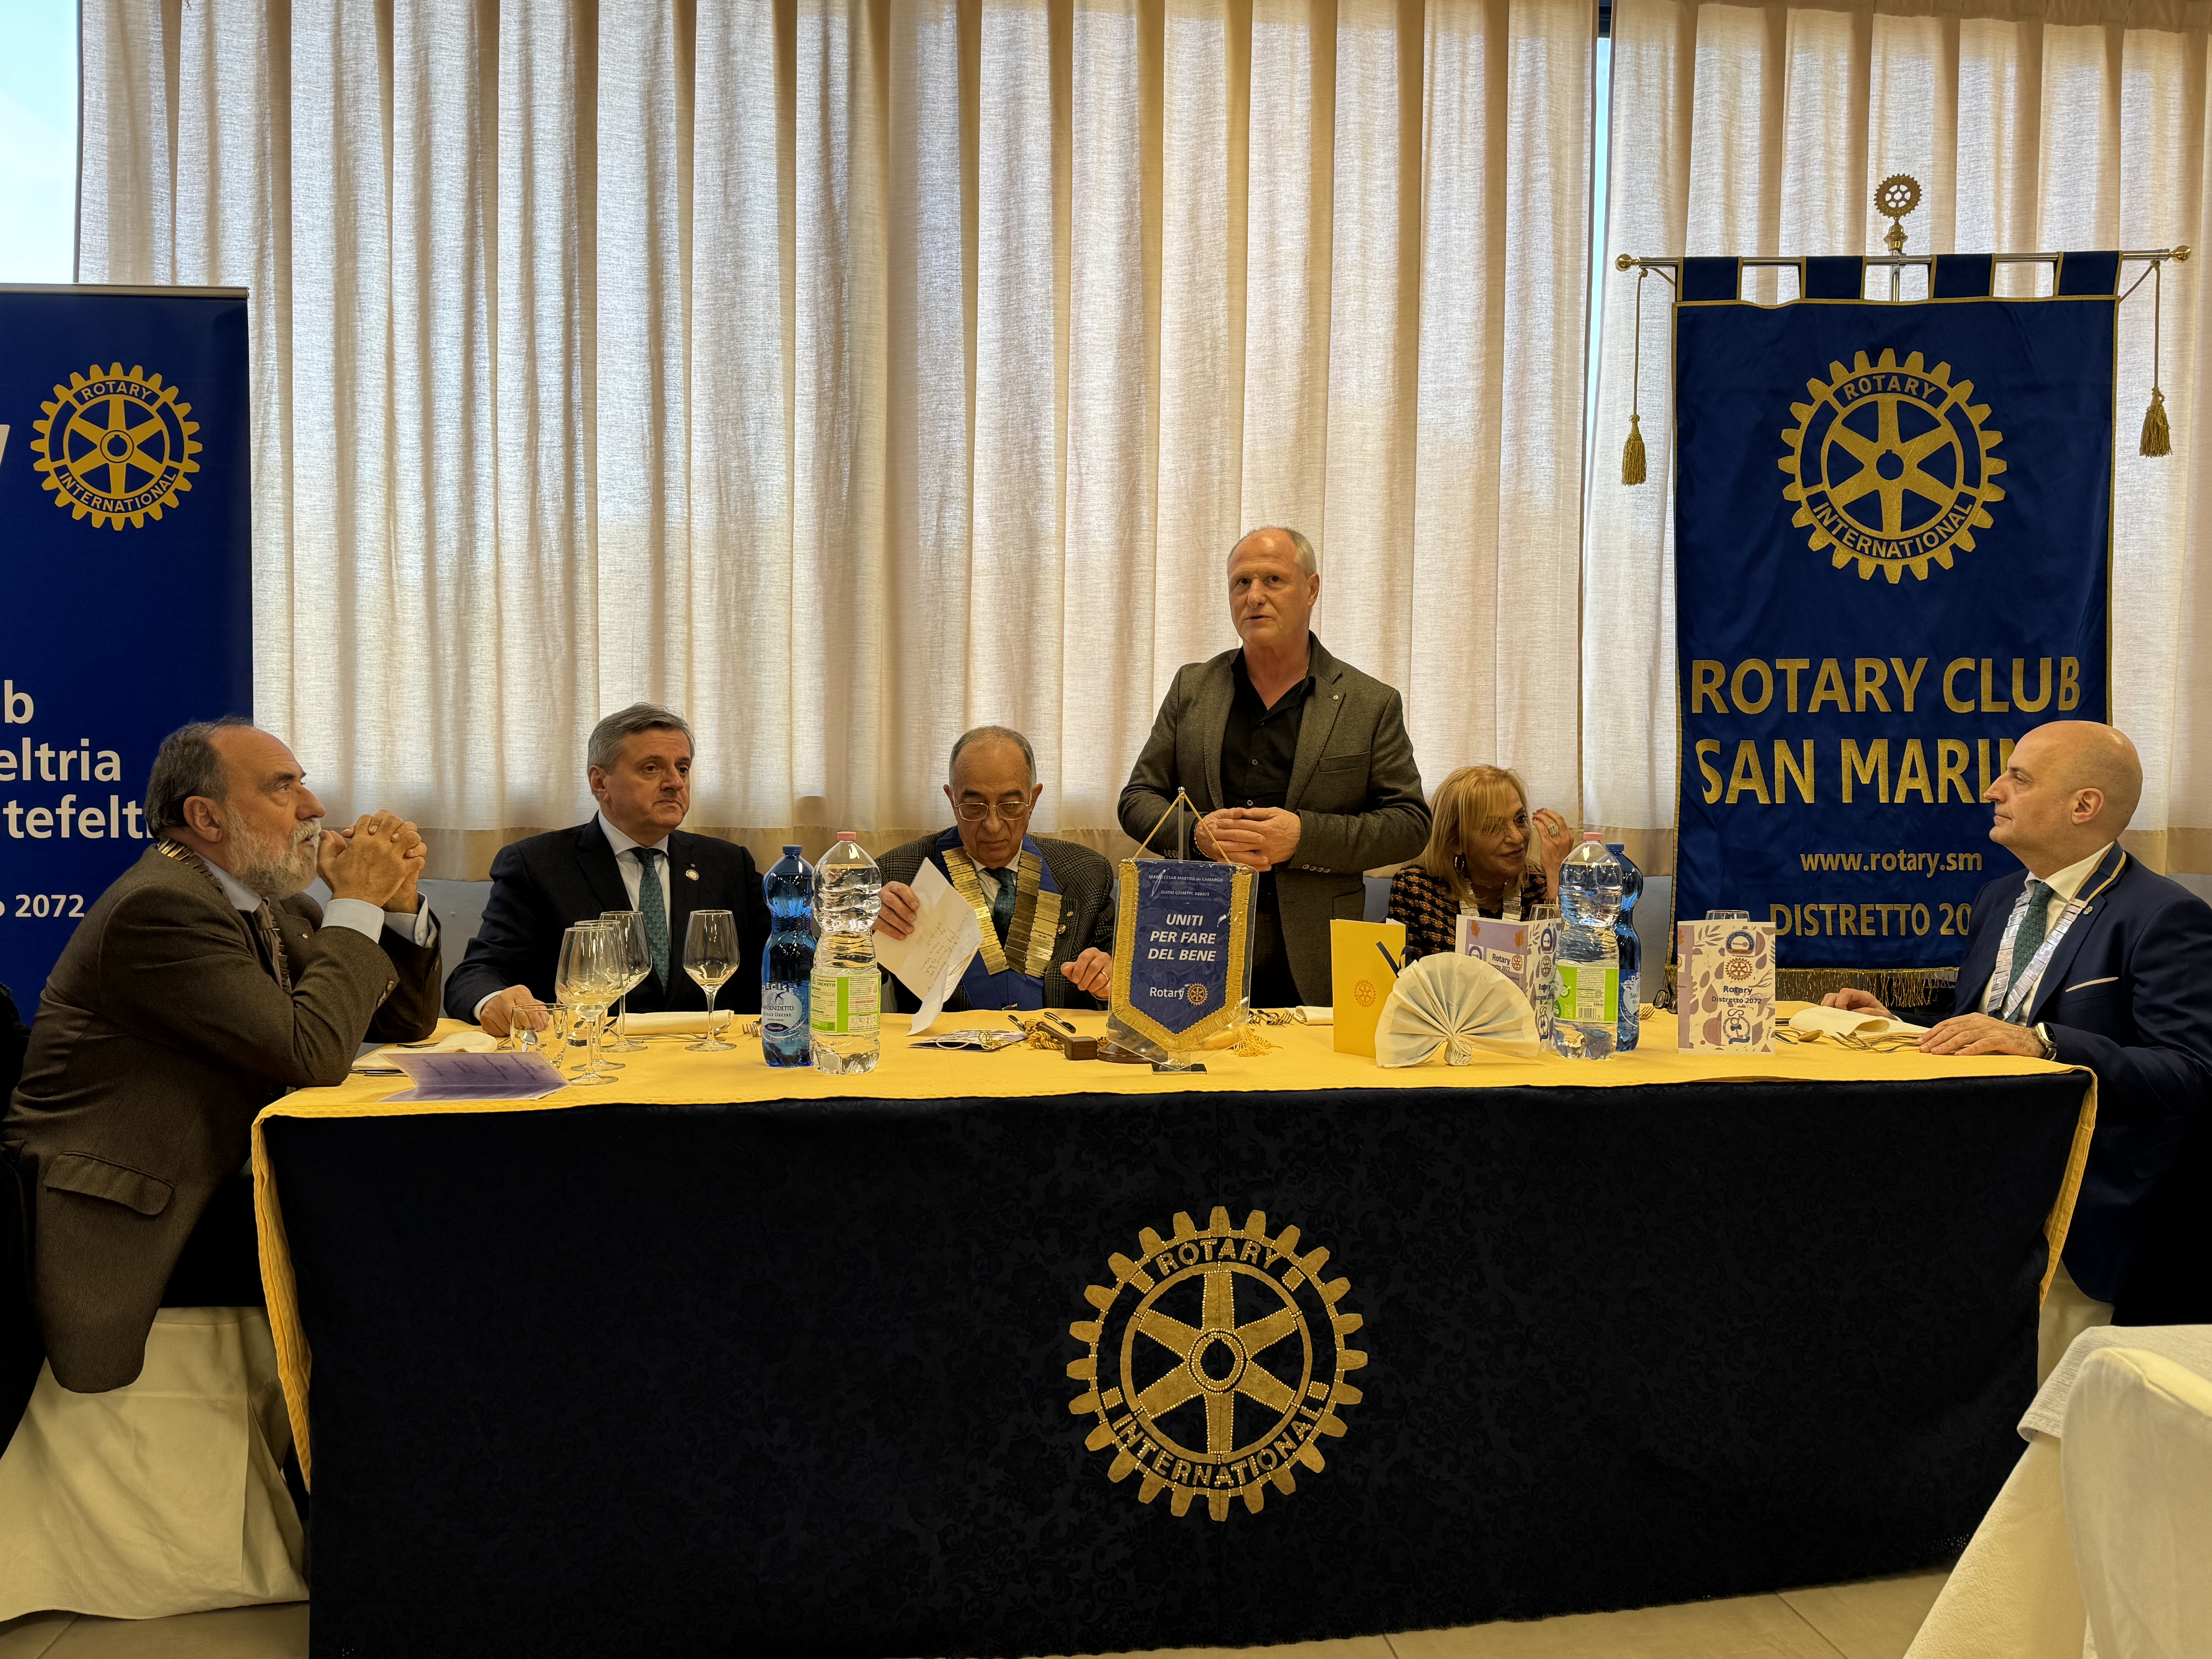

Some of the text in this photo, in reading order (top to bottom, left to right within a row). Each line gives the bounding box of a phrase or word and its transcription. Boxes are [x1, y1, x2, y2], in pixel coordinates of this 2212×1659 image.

[81, 381, 152, 400] ROTARY
[1843, 375, 1937, 400] ROTARY
[59, 472, 177, 512] INTERNATIONAL
[1813, 501, 1973, 558] INTERNATIONAL
[1692, 656, 2080, 714] ROTARY CLUB
[0, 737, 121, 781] eltria
[1695, 739, 1815, 804] SAN
[3, 794, 154, 839] tefelt
[1800, 849, 1982, 878] www.rotary.sm
[15, 894, 84, 917] 2072
[1166, 914, 1204, 926] UNITI
[1770, 903, 1930, 936] DISTRETTO
[1150, 931, 1217, 944] PER FARE
[1147, 948, 1217, 962] DEL BENE
[1492, 953, 1510, 965] Rotary
[1150, 987, 1185, 1000] Rotary
[1723, 985, 1753, 996] Rotary
[1156, 1238, 1283, 1276] ROTARY
[1112, 1405, 1324, 1487] INTERNATIONAL
